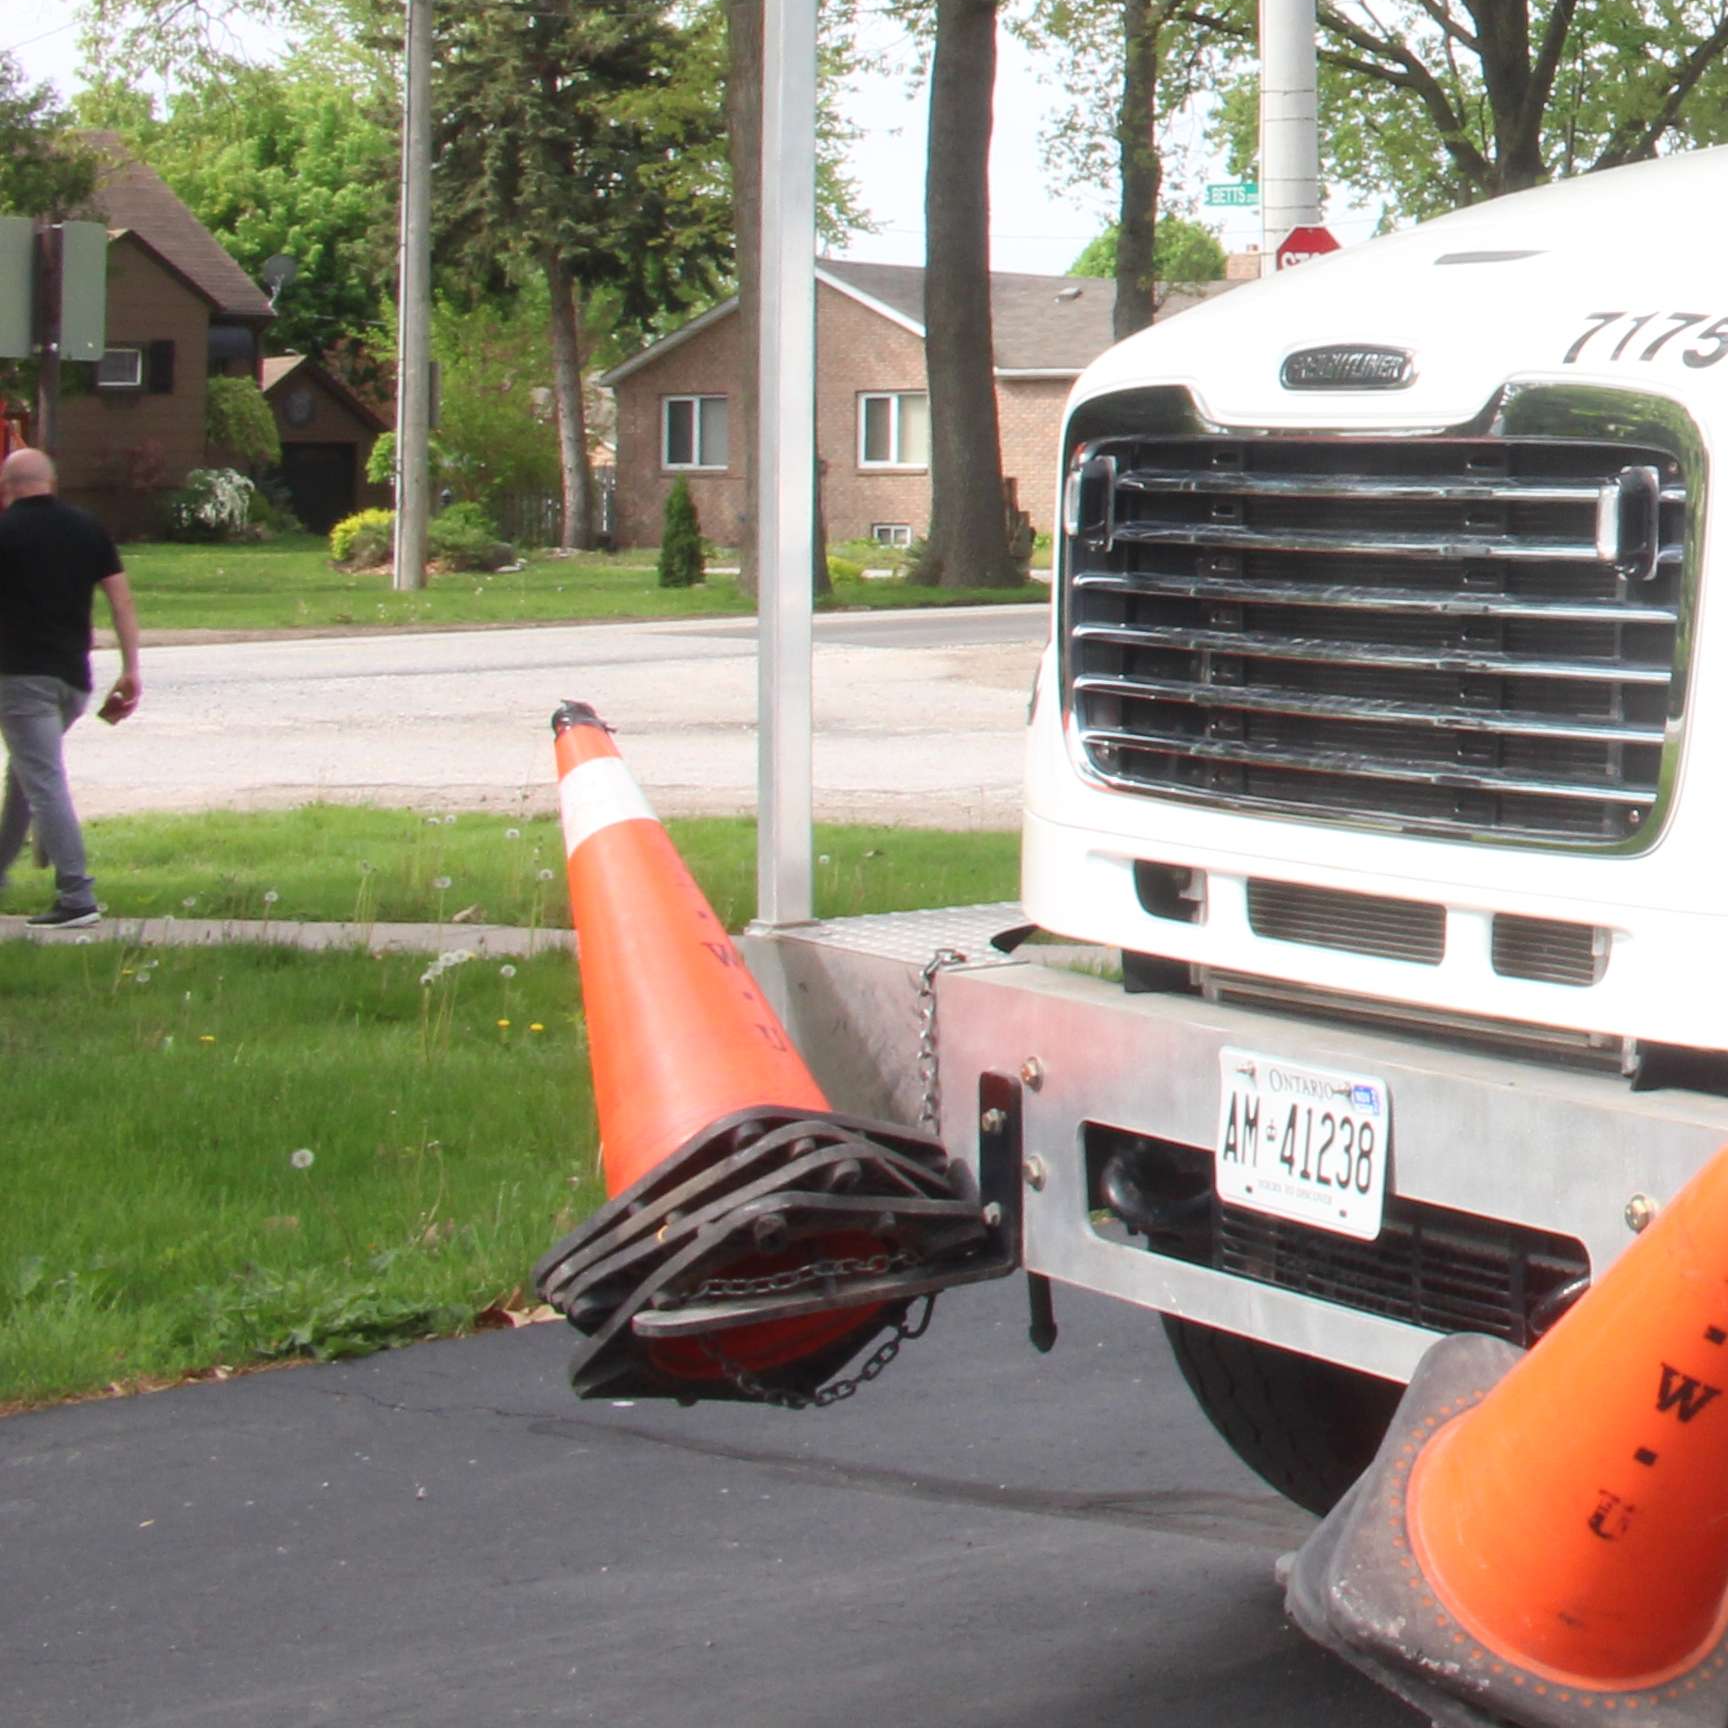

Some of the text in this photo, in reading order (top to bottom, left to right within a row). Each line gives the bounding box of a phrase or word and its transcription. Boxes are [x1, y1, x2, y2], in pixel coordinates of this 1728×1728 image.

[1211, 186, 1246, 203] BETTS
[1223, 1091, 1375, 1195] AM 41238
